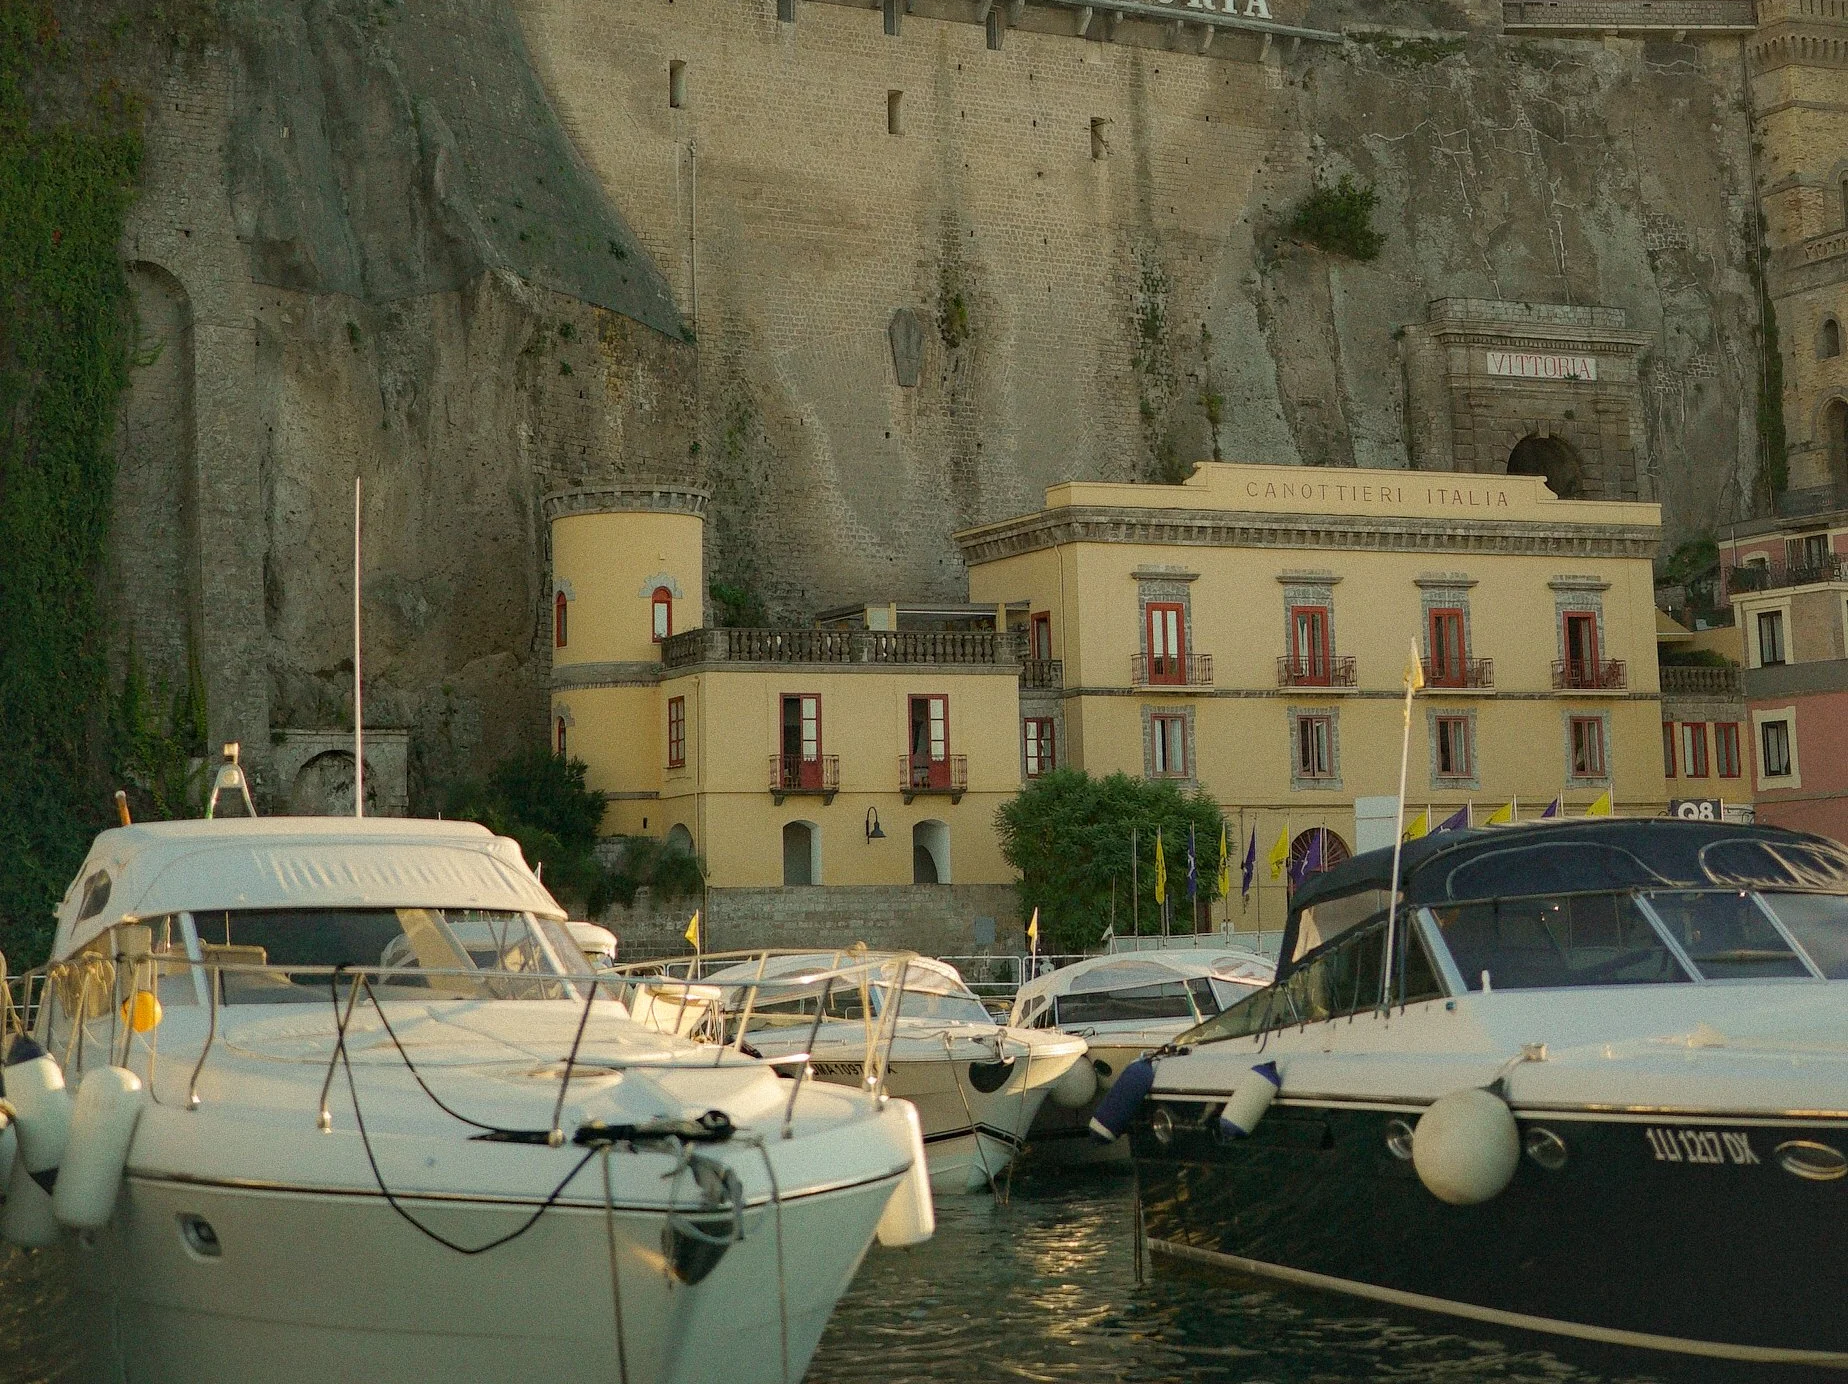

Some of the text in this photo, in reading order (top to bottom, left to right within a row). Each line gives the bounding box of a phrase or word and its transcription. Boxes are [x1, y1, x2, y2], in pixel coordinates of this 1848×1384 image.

[1491, 353, 1592, 379] VITTORIA
[1245, 481, 1509, 507] CANOTTIERI ITALIA
[1677, 801, 1715, 821] Q8
